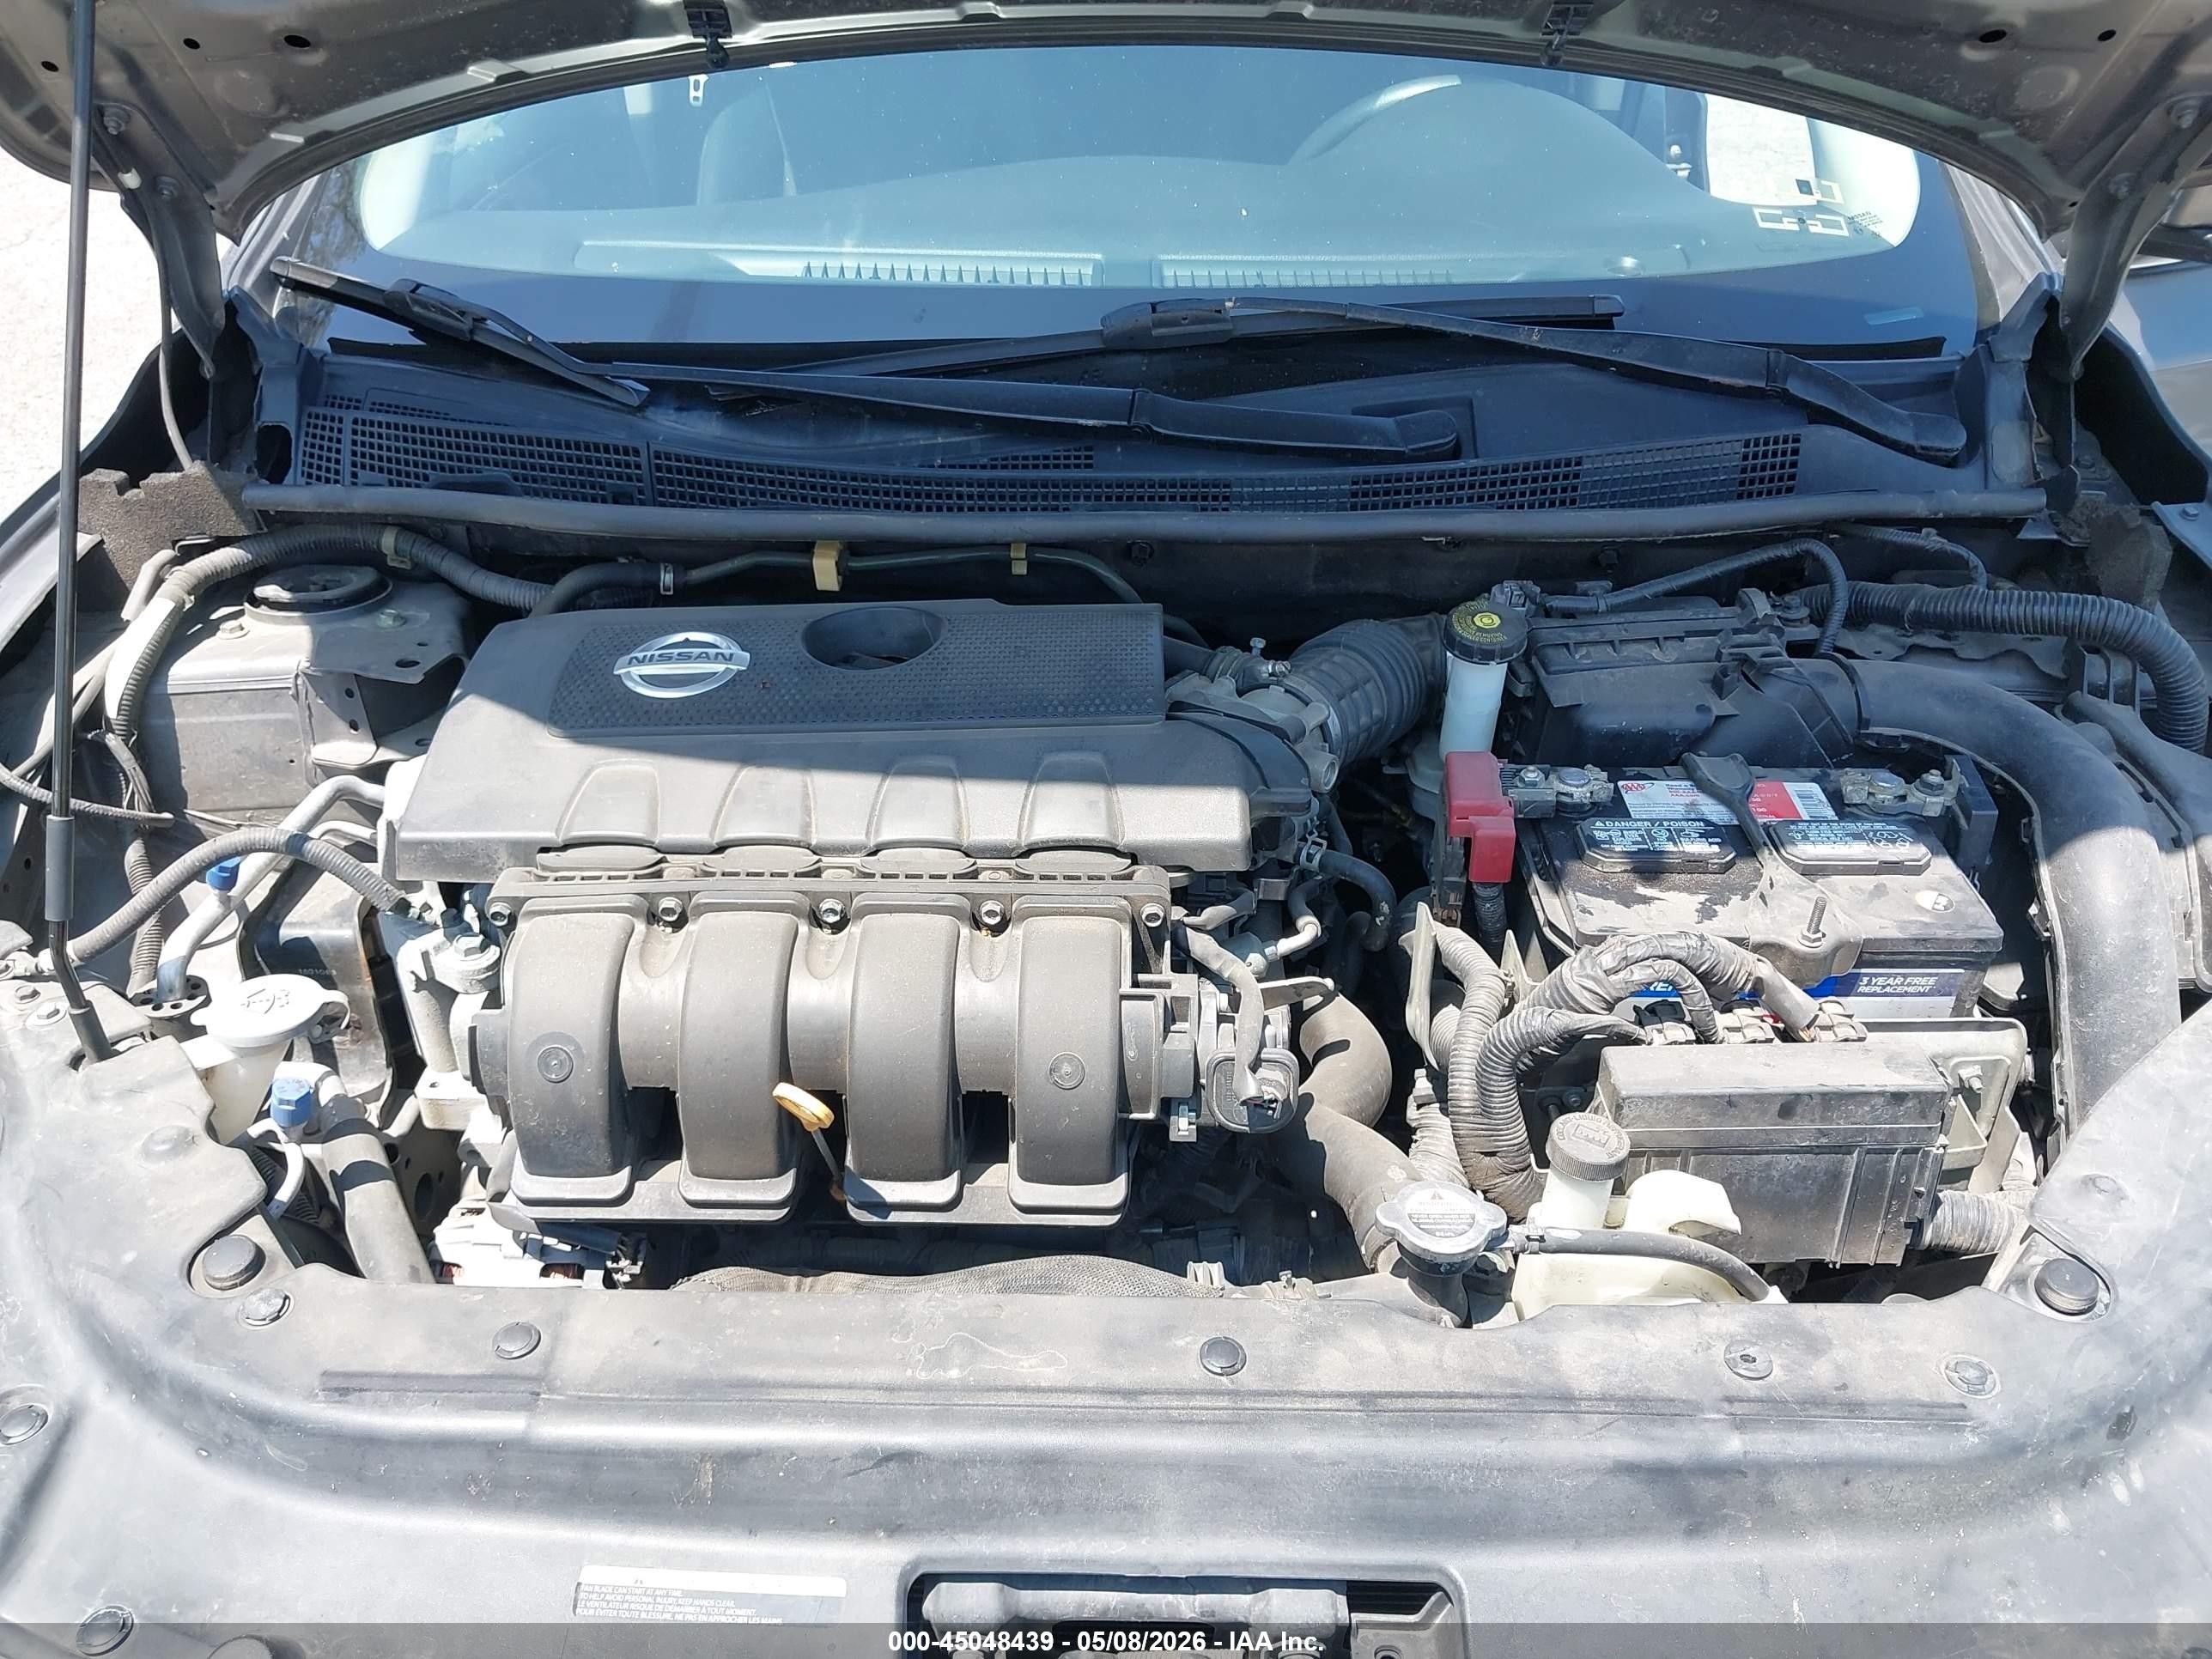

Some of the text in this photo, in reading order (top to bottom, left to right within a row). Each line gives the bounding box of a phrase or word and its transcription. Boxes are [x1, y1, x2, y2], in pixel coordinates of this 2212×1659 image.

[628, 651, 734, 665] NISSAN
[1859, 976, 1938, 986] 3 YEAR FREE
[593, 1584, 614, 1594] BLADE
[614, 1586, 627, 1595] CAN
[628, 1586, 645, 1595] START
[654, 1588, 666, 1596] ANY
[605, 1594, 624, 1602] AVOID
[624, 1595, 654, 1603] PERSONAL
[678, 1597, 692, 1607] KEEP
[693, 1598, 714, 1607] HANDS
[577, 1600, 586, 1608] LE
[586, 1601, 629, 1610] VENTILATEUR
[707, 1607, 725, 1615] TOUT
[576, 1607, 595, 1616] POUR
[618, 1609, 640, 1619] TOUTE
[674, 1612, 684, 1621] NE
[684, 1613, 697, 1622] PAS
[698, 1613, 708, 1622] EN
[708, 1614, 748, 1624] APPROCHER
